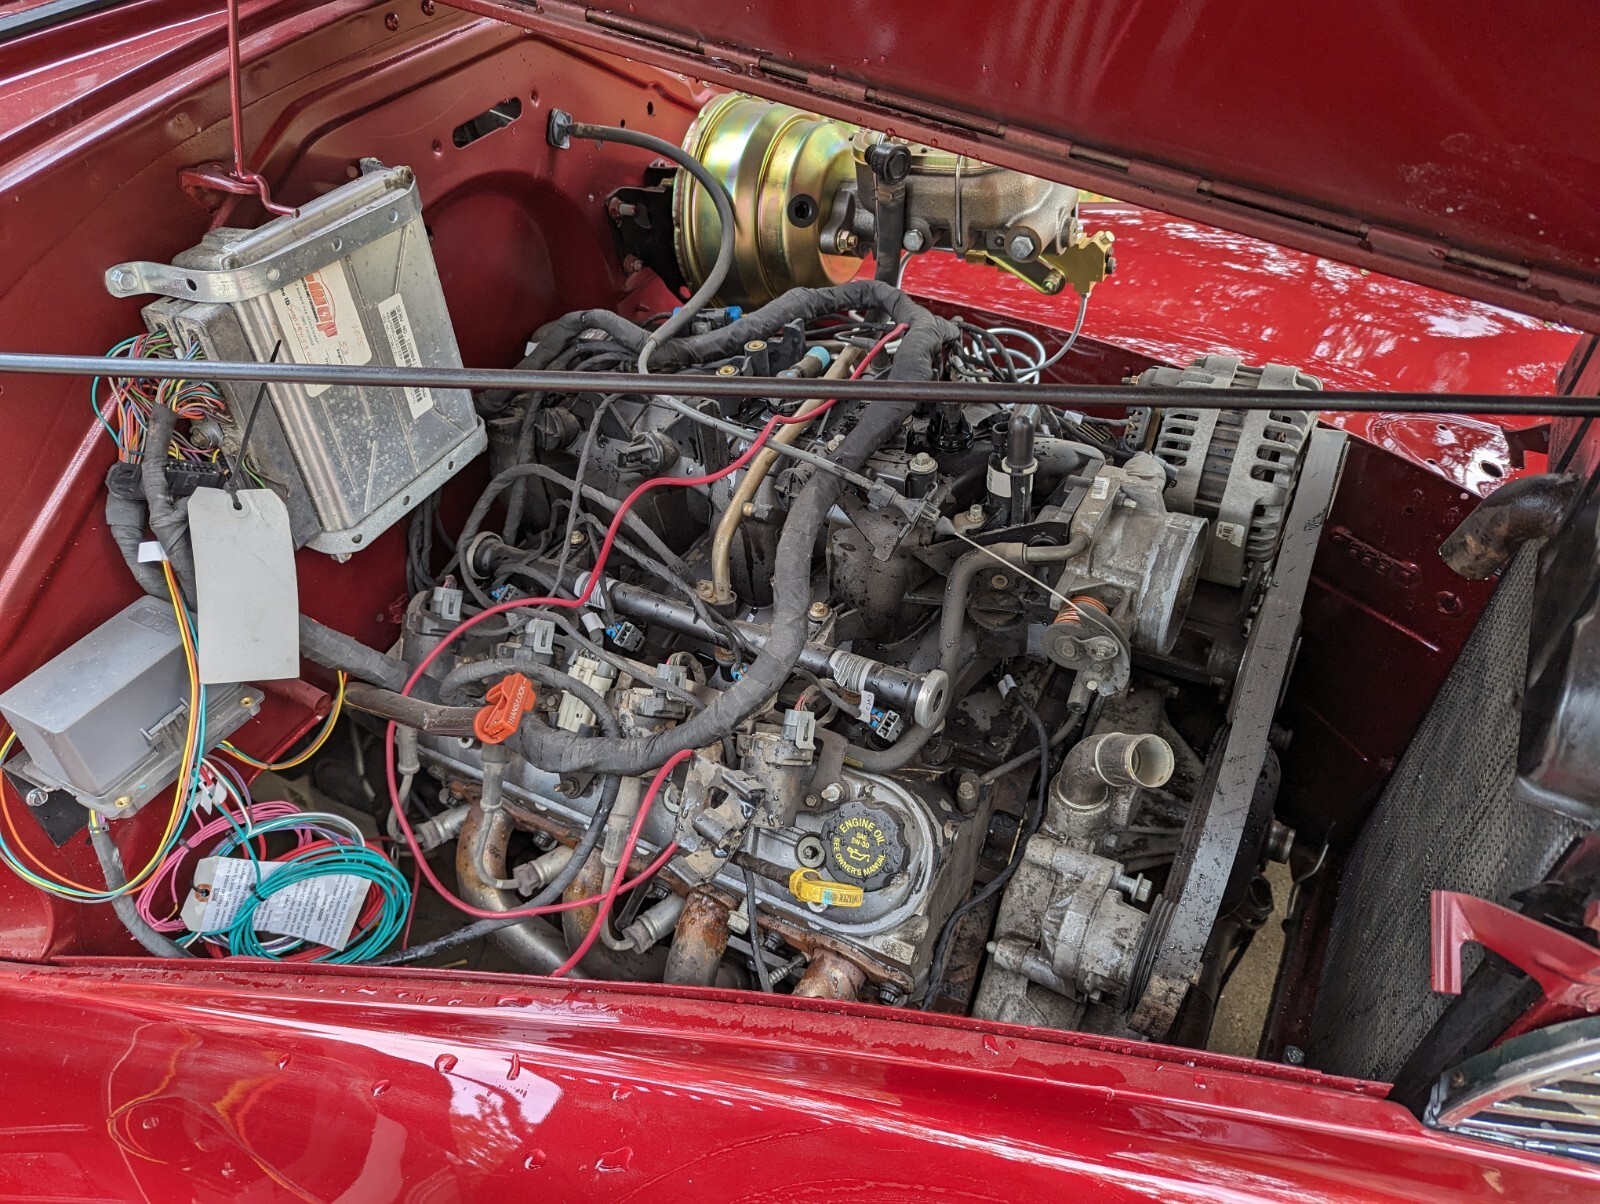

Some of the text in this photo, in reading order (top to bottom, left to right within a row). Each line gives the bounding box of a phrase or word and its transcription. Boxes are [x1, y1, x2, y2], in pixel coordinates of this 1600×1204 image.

[507, 684, 526, 726] TRANS/LOCK
[839, 817, 886, 846] ENGINE OIL
[856, 832, 867, 842] SAE
[850, 838, 870, 849] 5W-30
[863, 853, 886, 875] MANUAL
